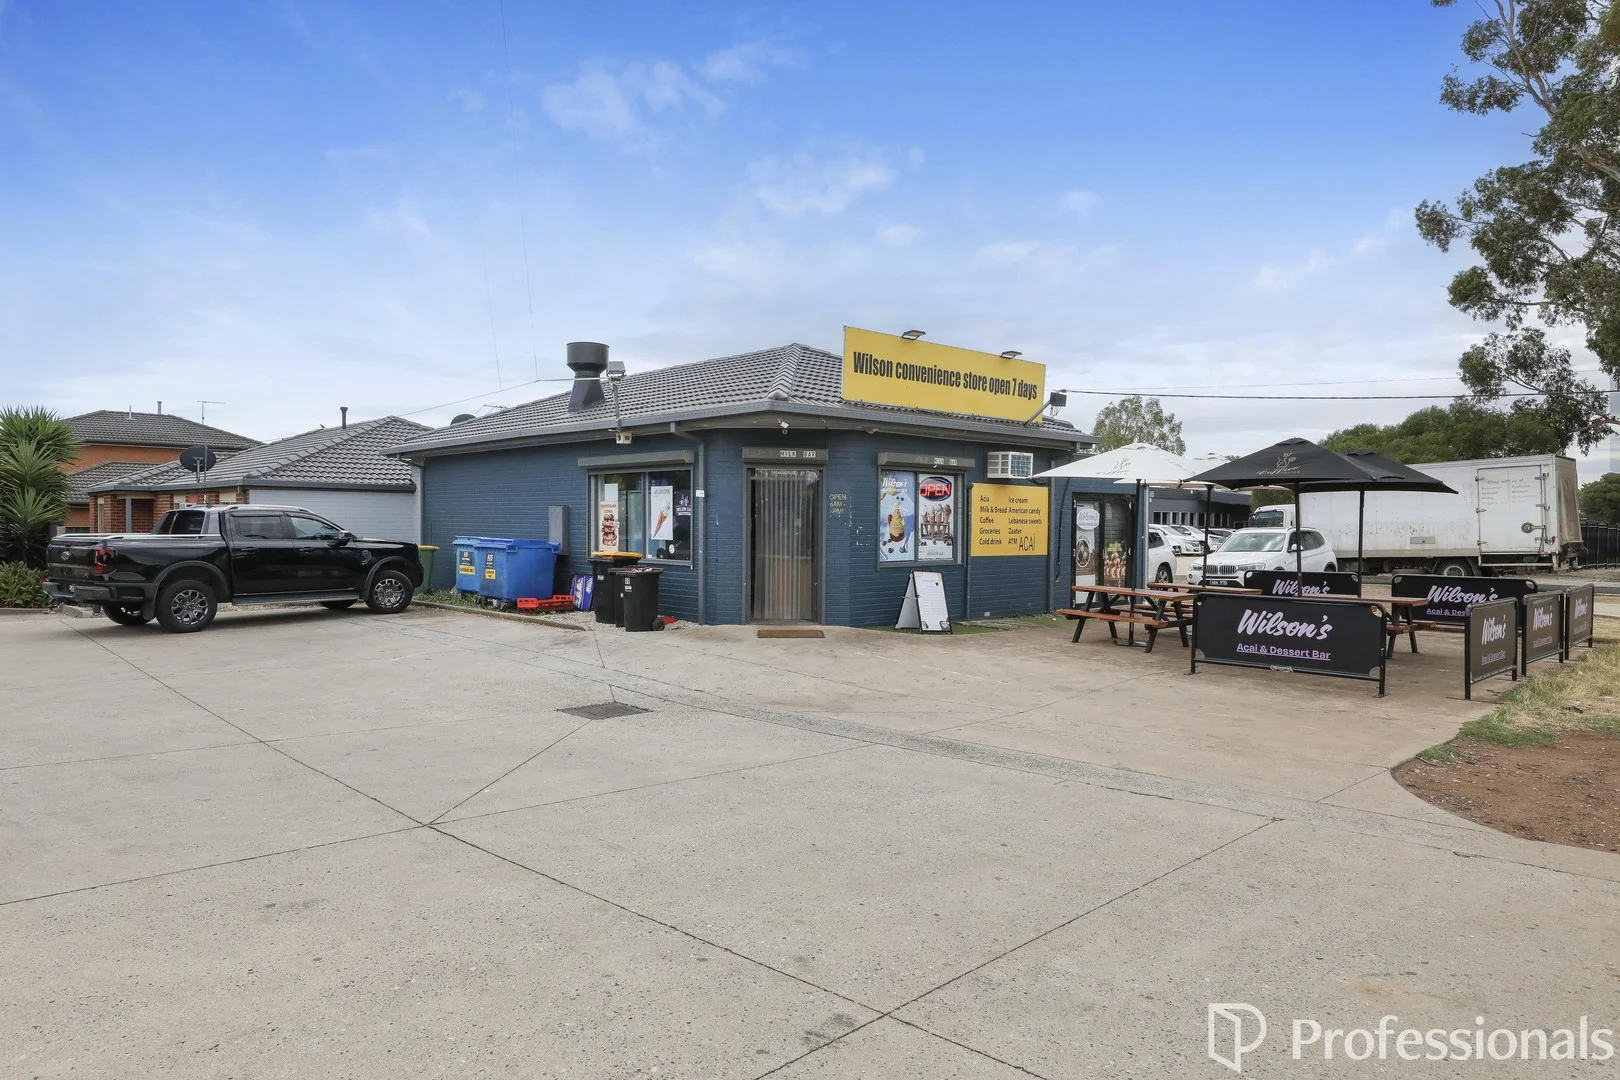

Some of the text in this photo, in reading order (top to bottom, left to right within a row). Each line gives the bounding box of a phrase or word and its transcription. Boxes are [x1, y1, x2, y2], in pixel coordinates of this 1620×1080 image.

[854, 352, 1038, 400] Wilson convenience store open 7 days
[919, 483, 951, 496] OPEN
[1237, 609, 1333, 640] Wilson's
[1482, 614, 1506, 645] Wilson's
[1533, 605, 1552, 631] Wilson's
[1237, 643, 1331, 660] Acai & Dessert Bar
